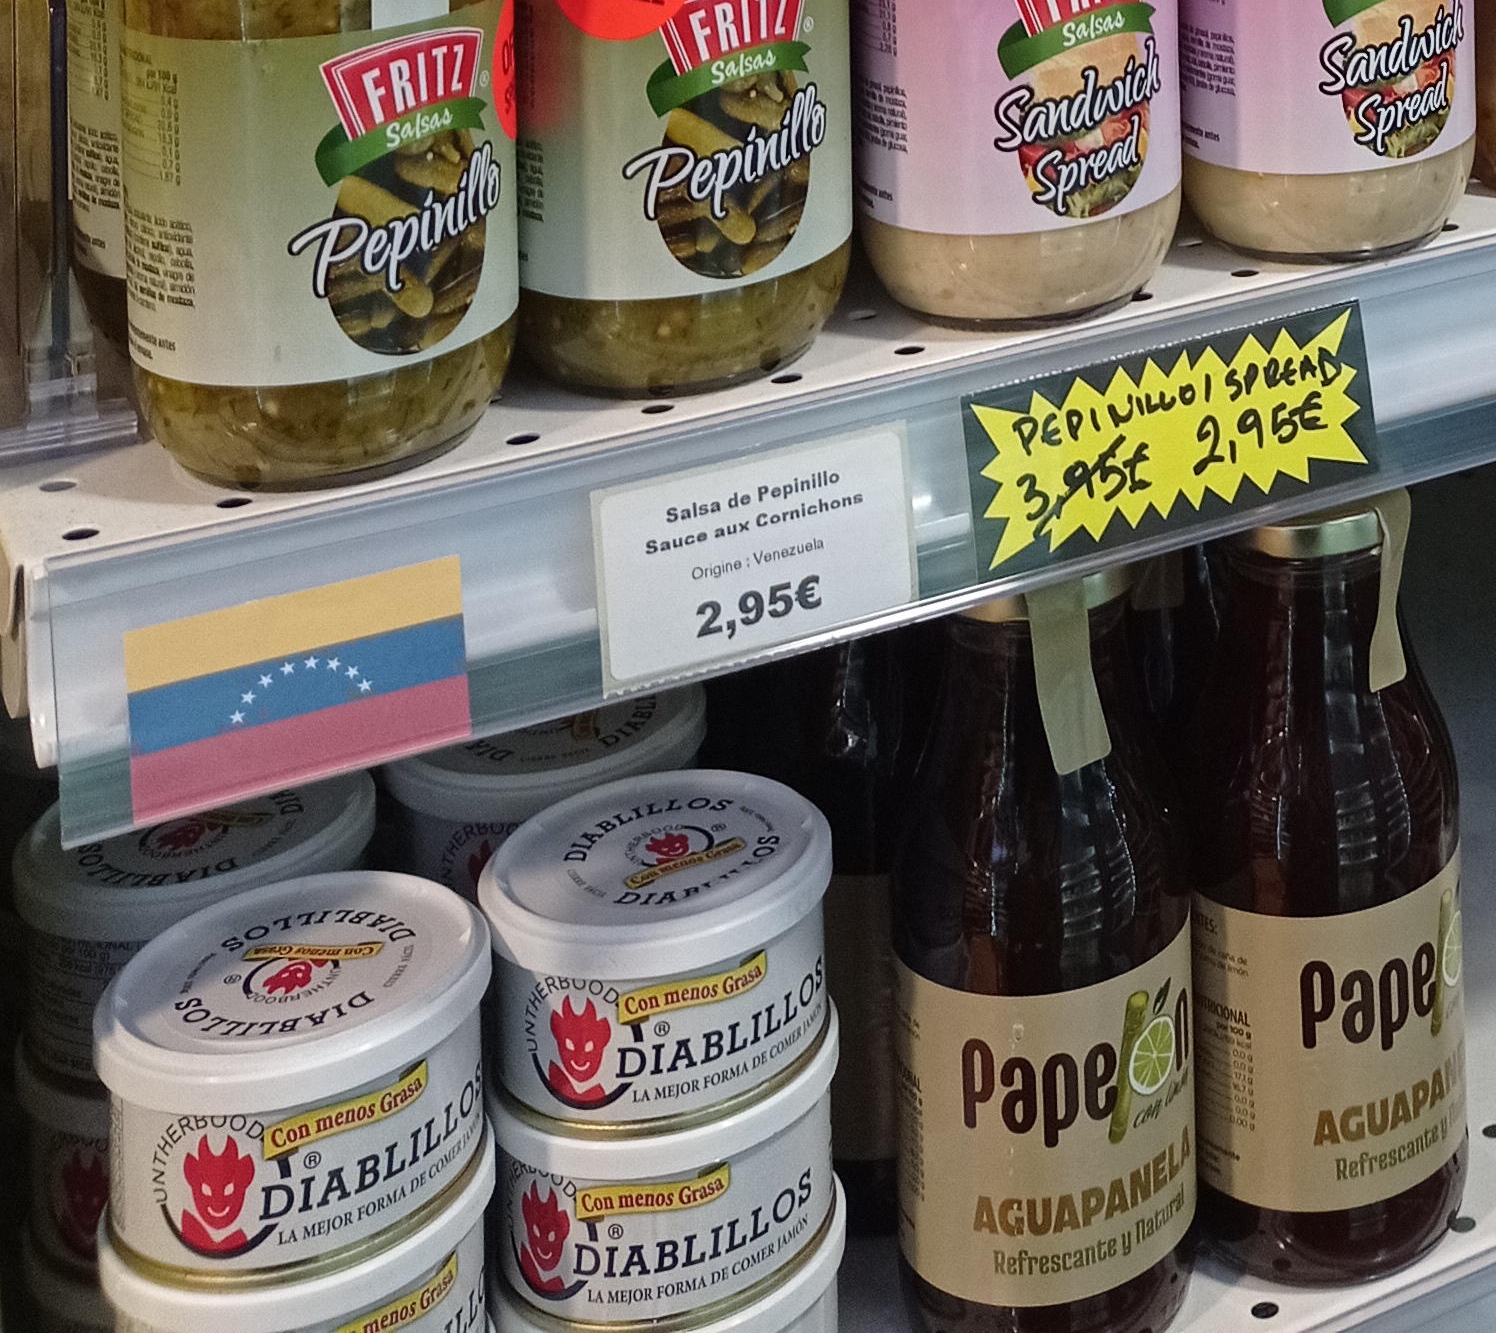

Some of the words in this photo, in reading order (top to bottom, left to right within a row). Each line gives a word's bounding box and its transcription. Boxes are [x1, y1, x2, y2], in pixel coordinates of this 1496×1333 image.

[1062, 10, 1125, 47] Salsas
[362, 41, 466, 125] FRITZ
[711, 47, 777, 85] Salsas
[995, 36, 1160, 152] Sandwich
[385, 106, 453, 151] Salsas
[1355, 62, 1447, 155] Spread
[623, 82, 826, 220] Pepinillo
[1033, 115, 1139, 216] Spread
[288, 140, 501, 298] Pepinillo
[1225, 347, 1343, 402] SPREAD
[645, 532, 708, 555] Sauce
[715, 521, 750, 538] aux
[756, 493, 863, 527] Cornichons
[666, 501, 721, 523] Salsa
[728, 493, 751, 509] de
[758, 471, 840, 502] Pepinillo
[692, 559, 742, 580] Origine
[753, 539, 824, 565] Venezuela
[696, 575, 823, 639] 2,95€
[563, 796, 735, 865] DIABLILLOS
[615, 954, 825, 1080] DIABLILLOS
[624, 995, 663, 1016] Con
[666, 983, 719, 1010] menos
[722, 963, 763, 996] Grasa
[259, 1064, 484, 1222] DIABLILLOS
[973, 1126, 1191, 1239] AGUAPANELA
[572, 1167, 813, 1280] DIABLILLOS
[993, 1235, 1118, 1277] Refrescante
[1121, 1231, 1132, 1257] y
